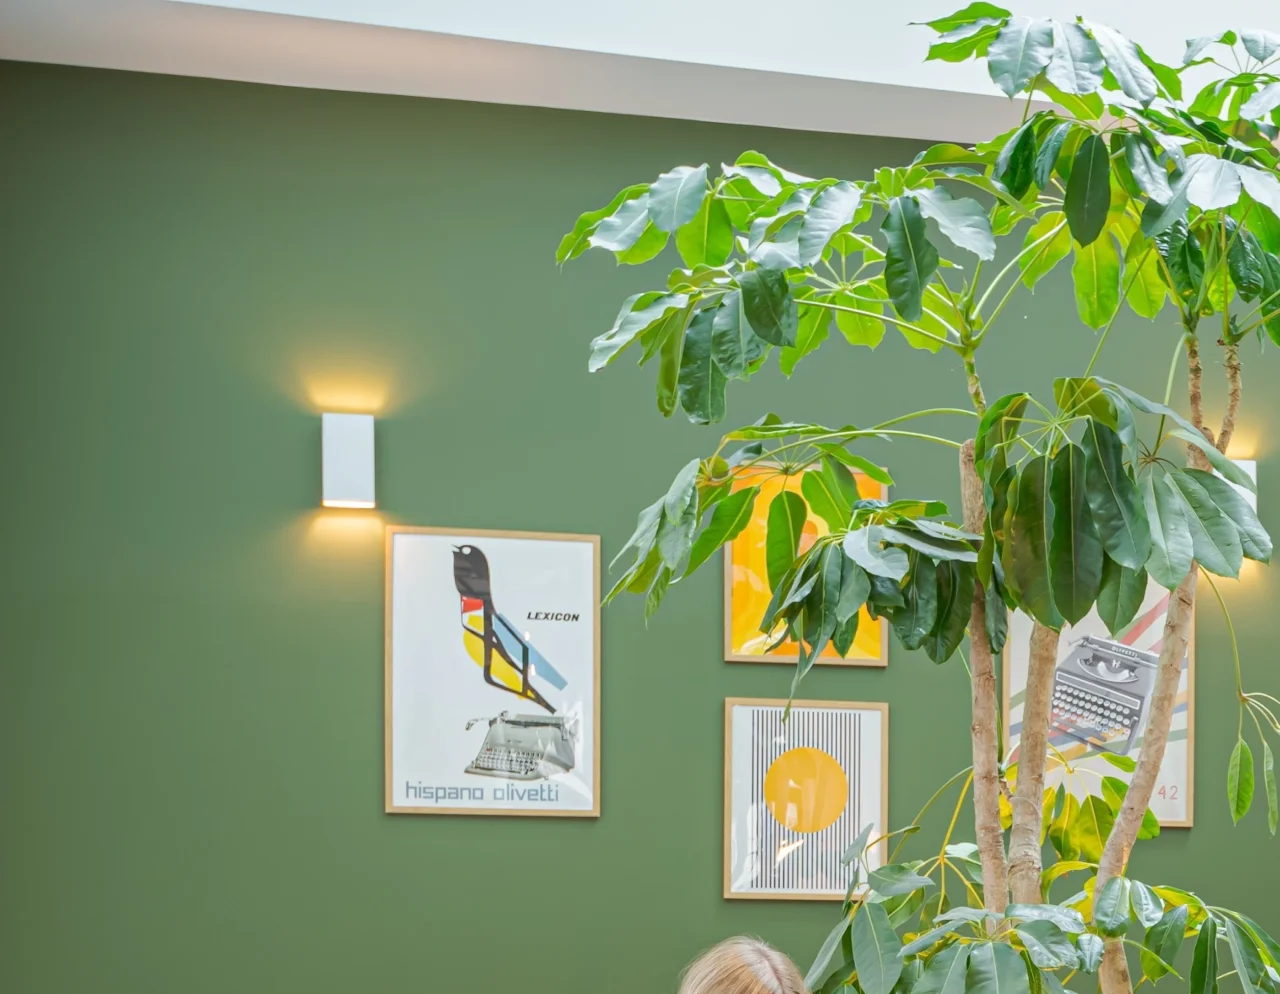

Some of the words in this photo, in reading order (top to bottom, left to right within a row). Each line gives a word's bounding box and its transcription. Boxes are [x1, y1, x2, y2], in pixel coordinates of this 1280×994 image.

[527, 611, 580, 622] LEXICON
[1111, 645, 1138, 657] OLIVETTI
[405, 781, 484, 804] hispano
[493, 783, 559, 802] olivetti
[1157, 784, 1179, 800] 42
